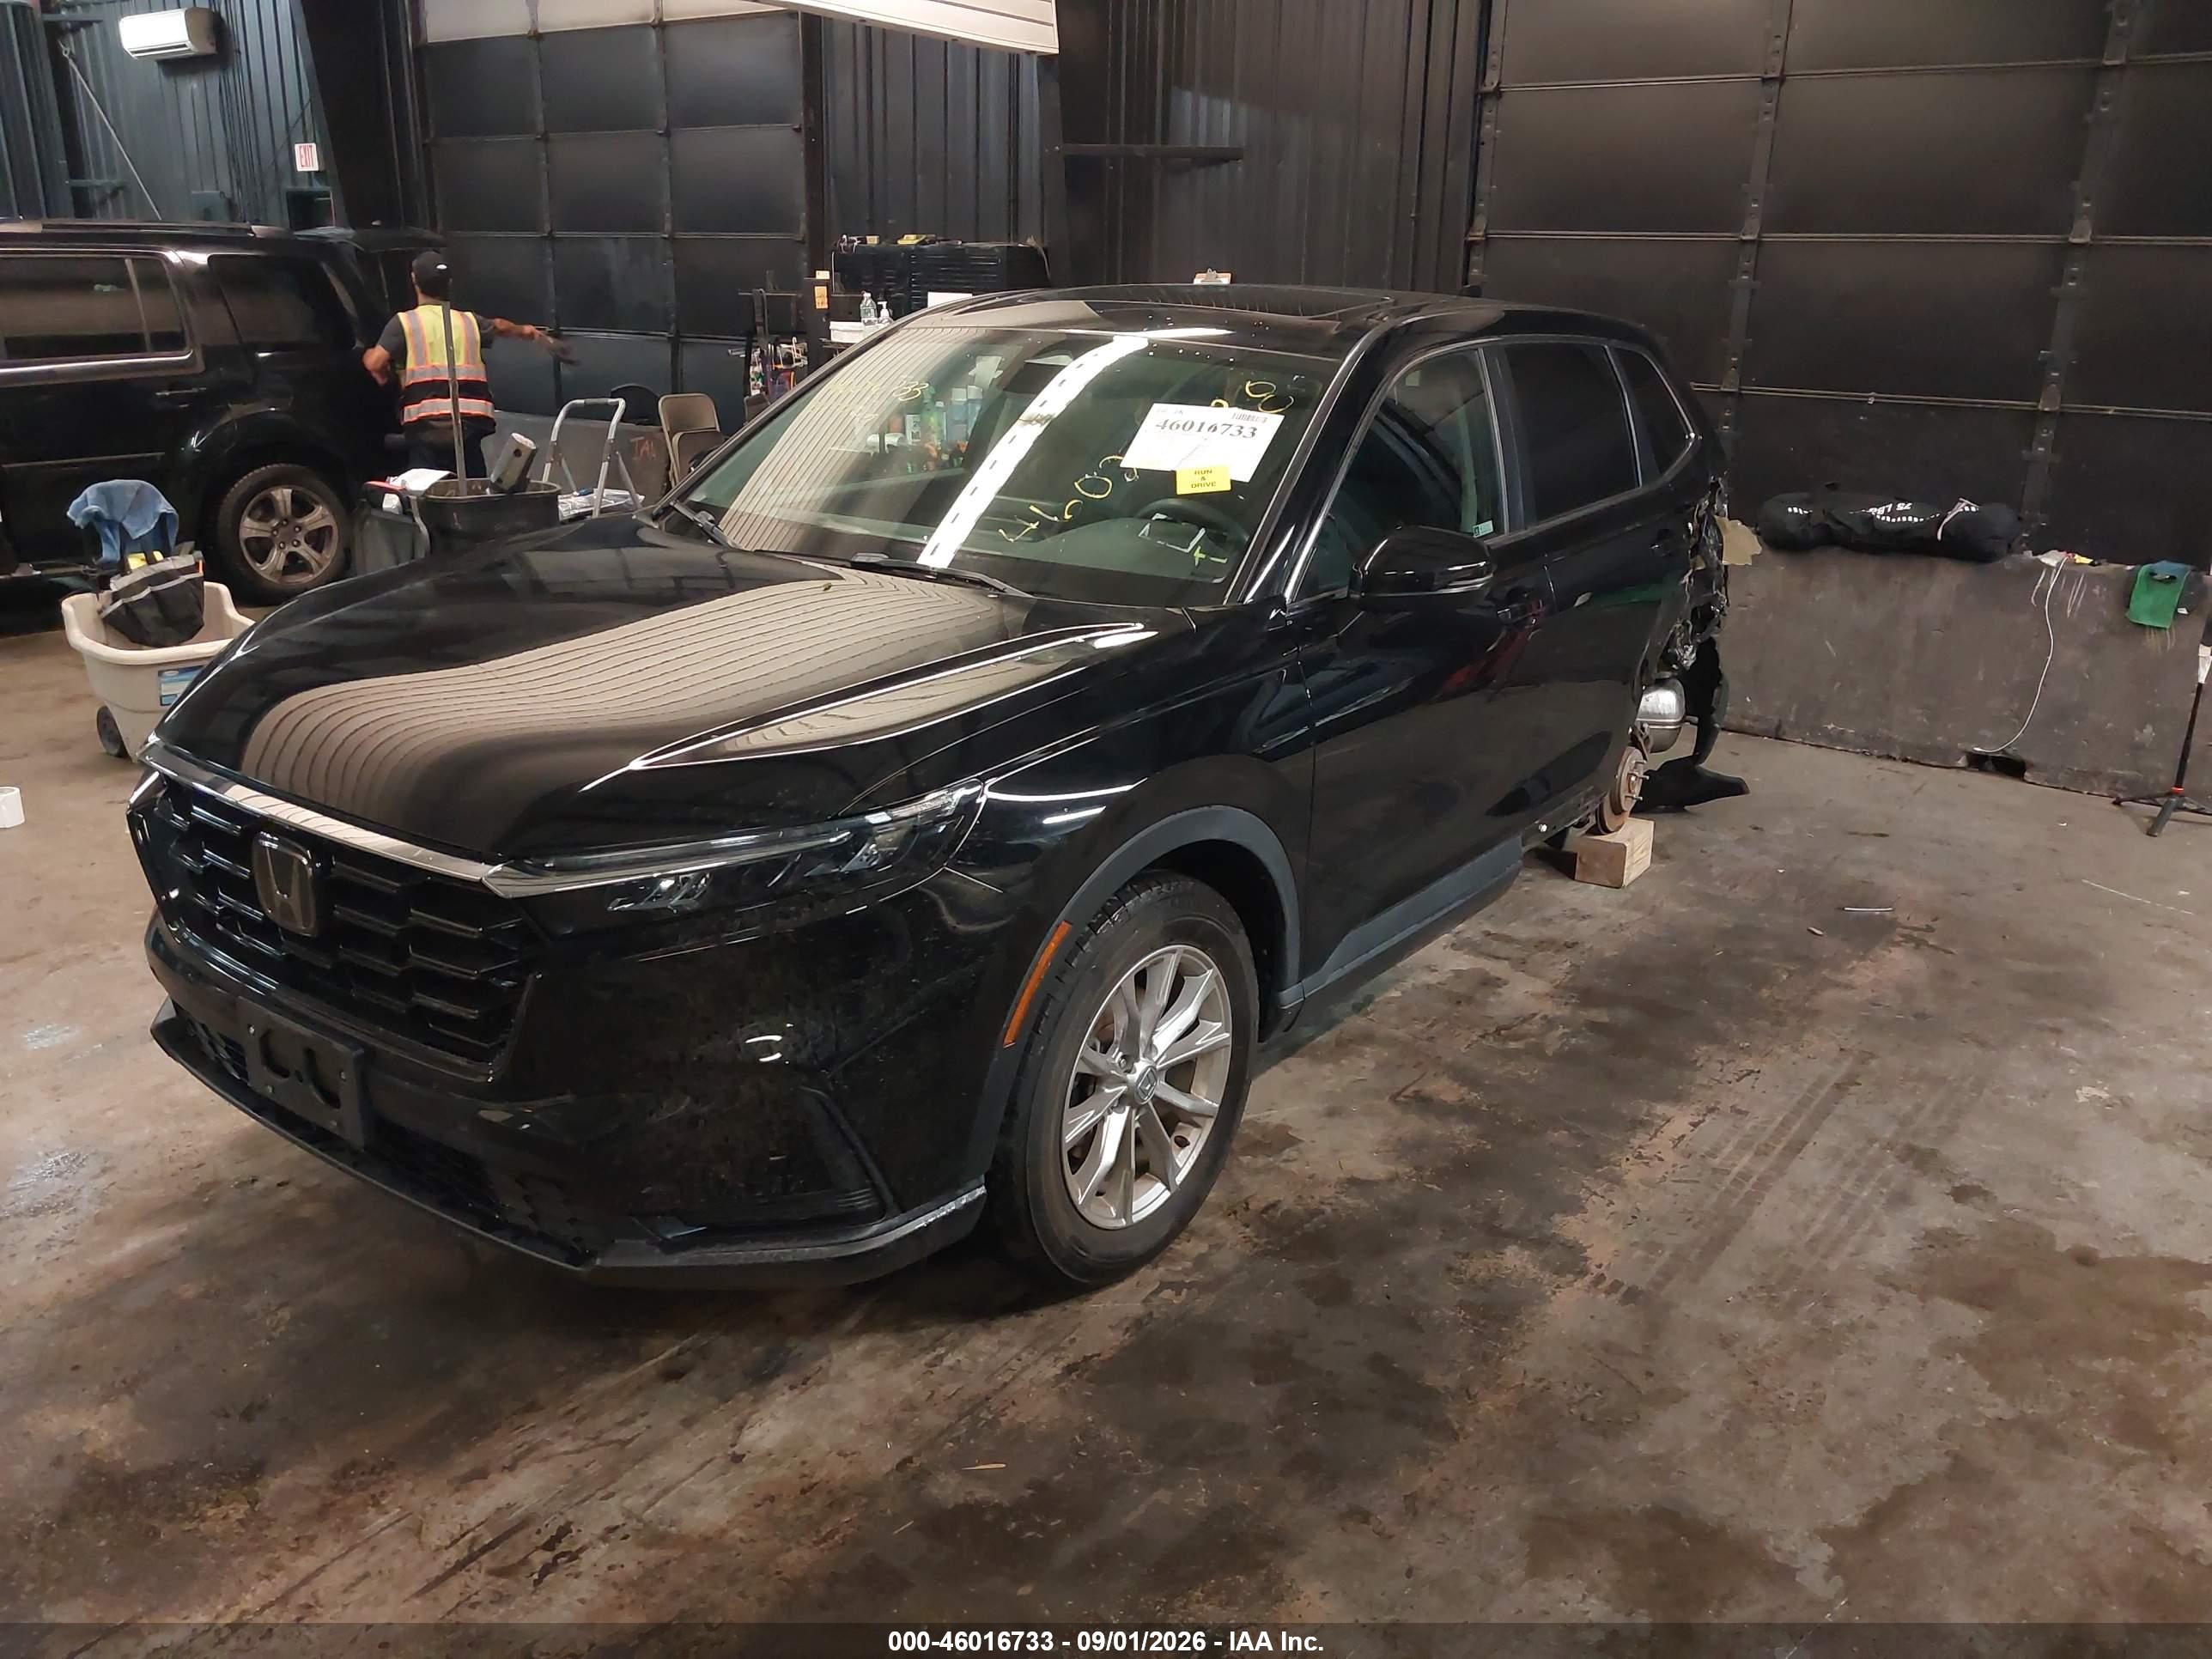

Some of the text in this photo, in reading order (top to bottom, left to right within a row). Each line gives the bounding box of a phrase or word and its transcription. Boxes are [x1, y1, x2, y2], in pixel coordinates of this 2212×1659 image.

[299, 144, 314, 167] EXIT
[1155, 418, 1258, 439] 46016733
[1895, 502, 1913, 511] 75
